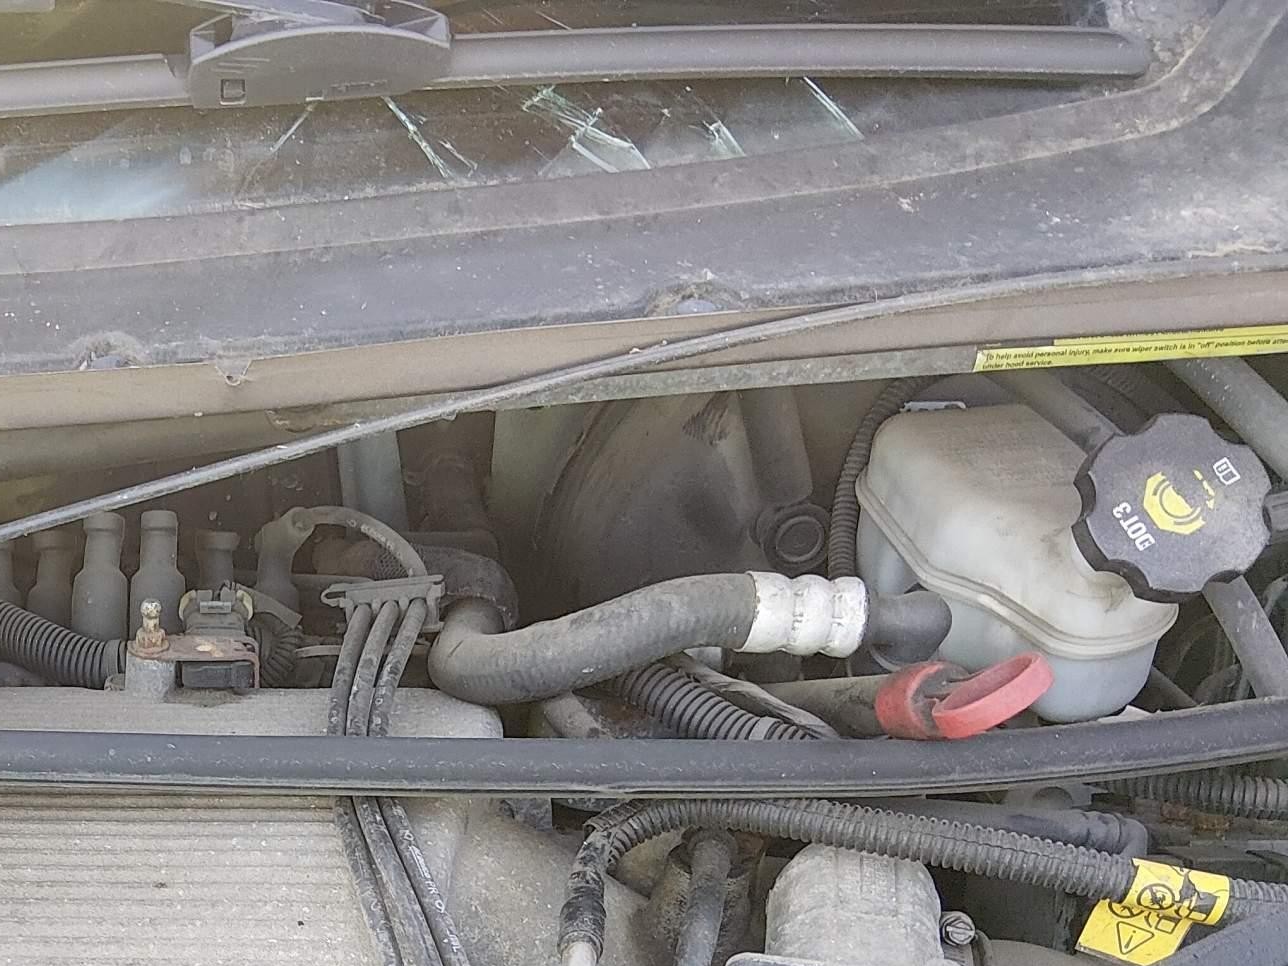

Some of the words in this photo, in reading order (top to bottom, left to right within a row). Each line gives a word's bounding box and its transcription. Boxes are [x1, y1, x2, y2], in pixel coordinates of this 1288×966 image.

[996, 352, 1011, 361] help
[1013, 351, 1034, 359] avoid
[1035, 349, 1068, 359] personal
[1132, 345, 1153, 355] wiper
[1215, 339, 1245, 349] position
[1246, 338, 1271, 346] before
[983, 361, 1004, 369] under
[1005, 360, 1024, 368] hood
[1112, 502, 1131, 519] 3
[1119, 515, 1156, 551] DOT
